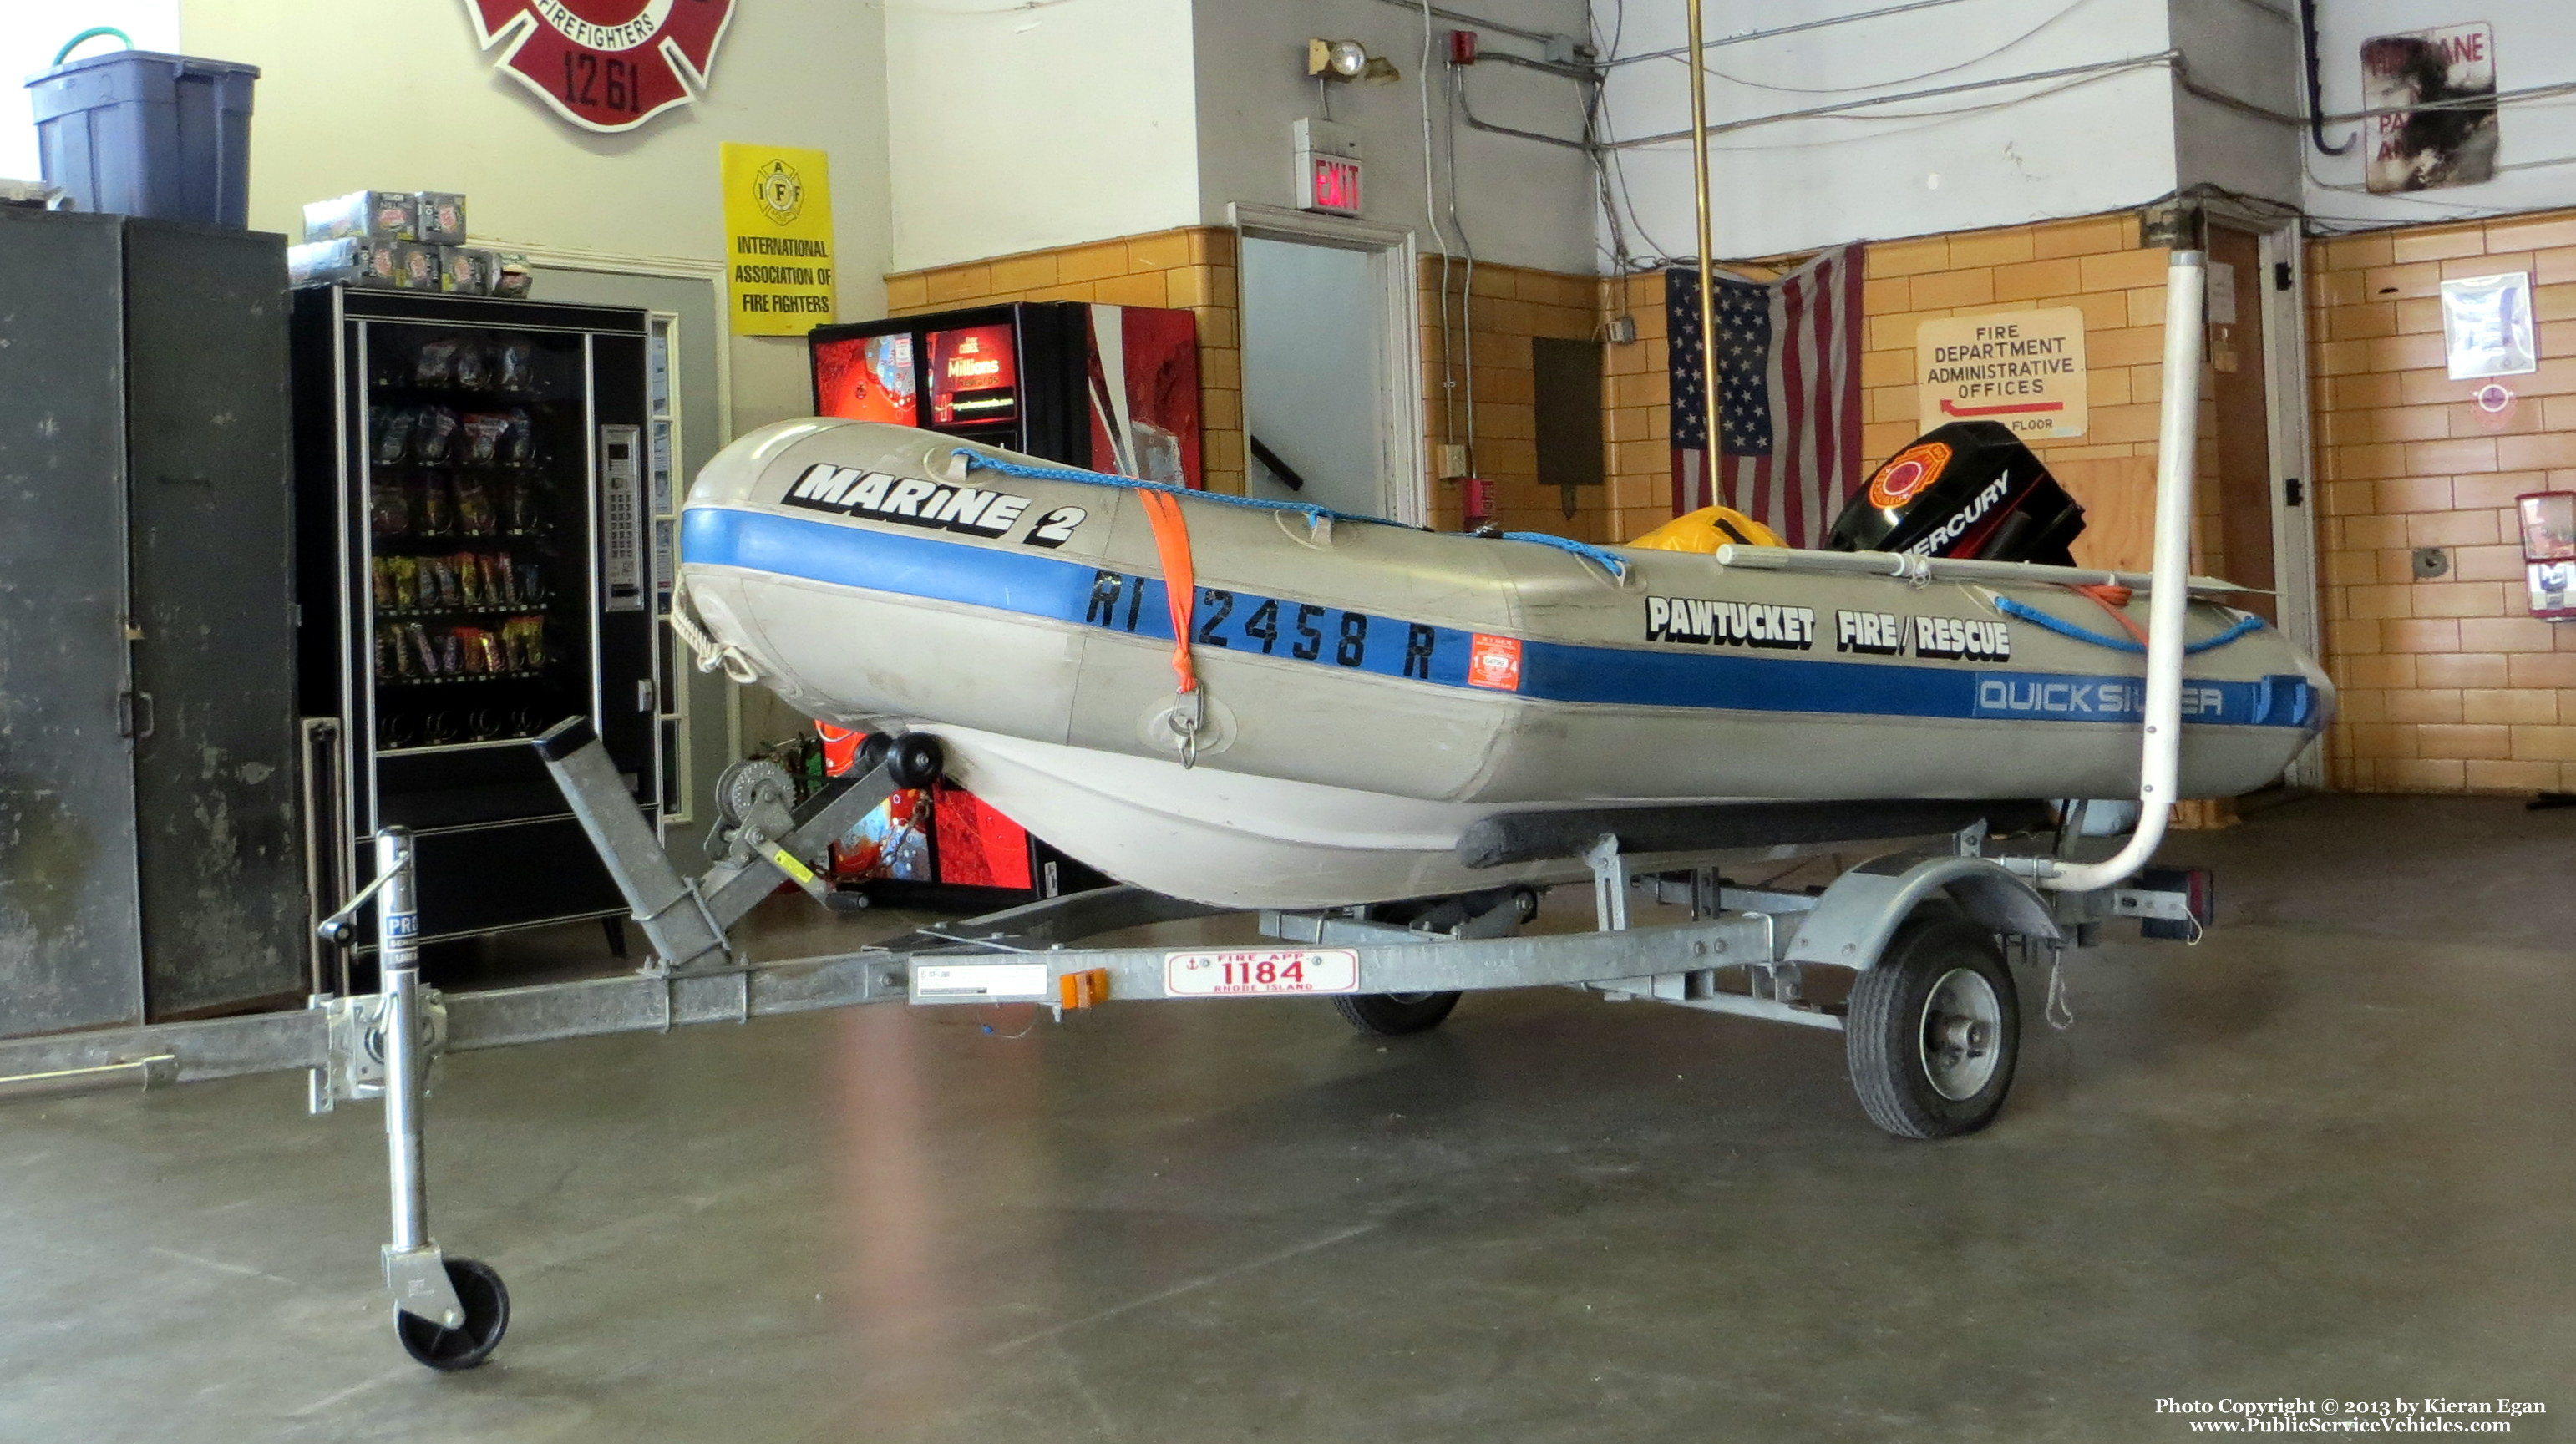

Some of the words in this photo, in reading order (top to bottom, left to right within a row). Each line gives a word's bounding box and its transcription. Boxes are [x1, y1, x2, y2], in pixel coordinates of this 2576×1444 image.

[538, 0, 654, 48] FIREFIGHTERS
[564, 51, 640, 114] 1261
[775, 183, 786, 201] F
[1316, 159, 1359, 210] EXIT
[737, 236, 829, 258] INTERNATIONAL
[735, 265, 814, 285] ASSOCIATION
[817, 268, 831, 286] OF
[742, 294, 769, 312] FIRE
[772, 295, 829, 313] FIGHTERS
[1976, 325, 2018, 341] FIRE
[1935, 337, 2066, 363] DEPARTMENT
[947, 357, 1000, 377] Millions
[1927, 357, 2074, 384] ADMINISTRATIVE
[1958, 378, 2044, 399] OFFICES
[2012, 419, 2052, 431] FLOOR
[1904, 469, 2009, 558] ERCURY
[1022, 505, 1088, 549] 2
[1087, 570, 1143, 631] RI
[1198, 590, 1367, 667] 2458
[1405, 623, 1436, 680] R
[1645, 595, 1816, 650] PAWTUCKET
[1980, 681, 2223, 716] QUICKSILER
[1222, 960, 1305, 985] 1184
[1214, 985, 1257, 993] RHODE
[1266, 983, 1313, 991] ISLAND
